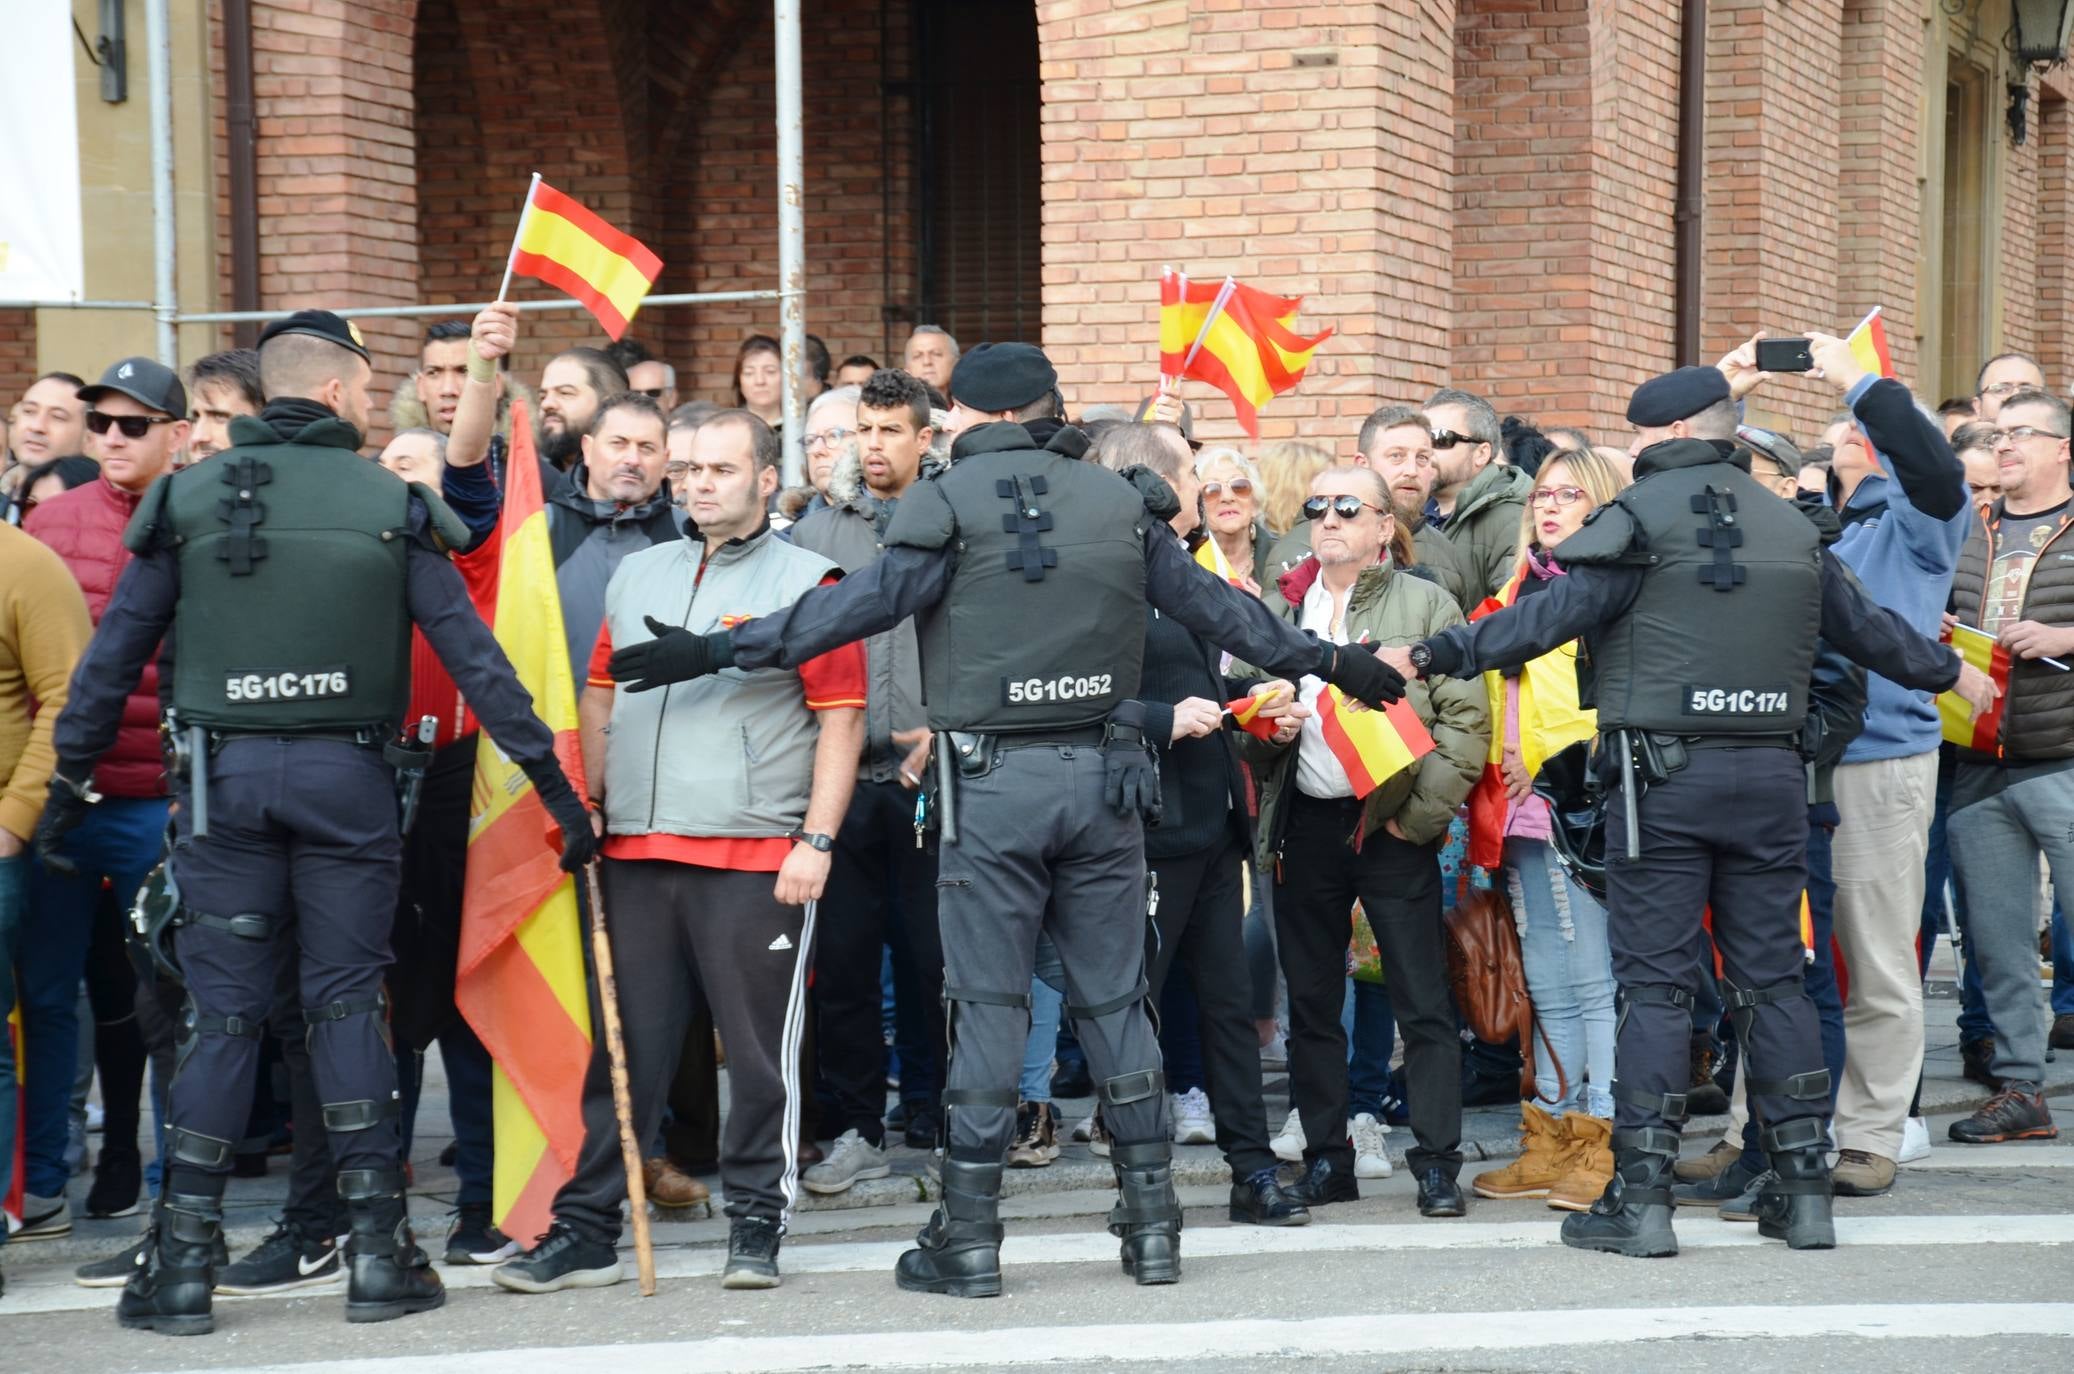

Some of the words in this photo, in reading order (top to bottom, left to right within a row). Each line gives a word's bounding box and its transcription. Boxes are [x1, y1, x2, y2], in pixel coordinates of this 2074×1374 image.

[226, 671, 348, 700] 5G1C176
[1008, 674, 1112, 702] 5G1C052
[1691, 689, 1788, 712] 5G1C174
